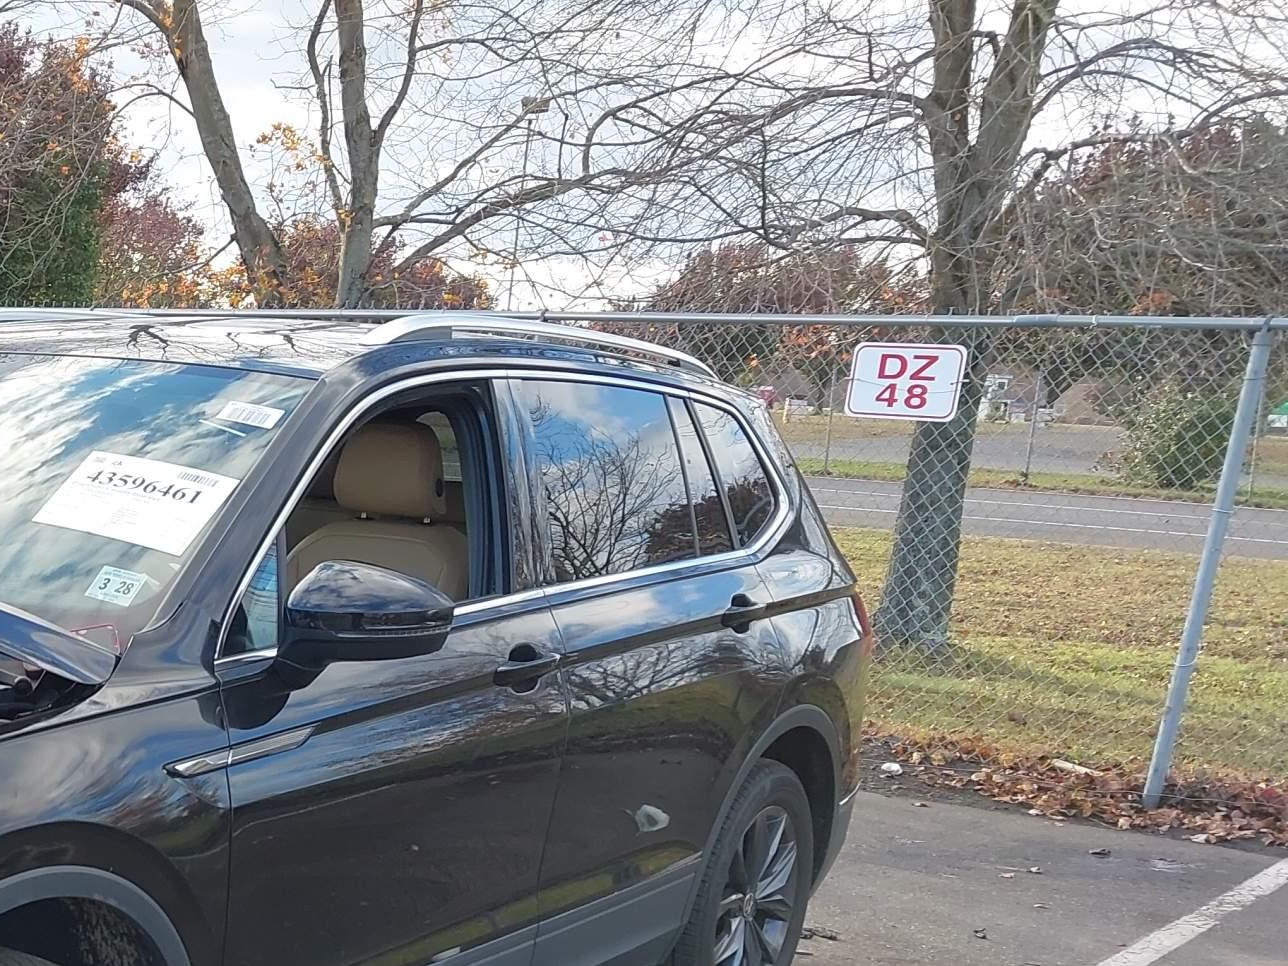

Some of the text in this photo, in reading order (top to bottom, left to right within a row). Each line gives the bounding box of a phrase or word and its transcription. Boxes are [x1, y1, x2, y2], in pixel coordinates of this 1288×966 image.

[877, 353, 940, 381] DZ
[875, 383, 928, 410] 48
[86, 469, 203, 504] 43596461
[98, 577, 135, 596] 3 28
